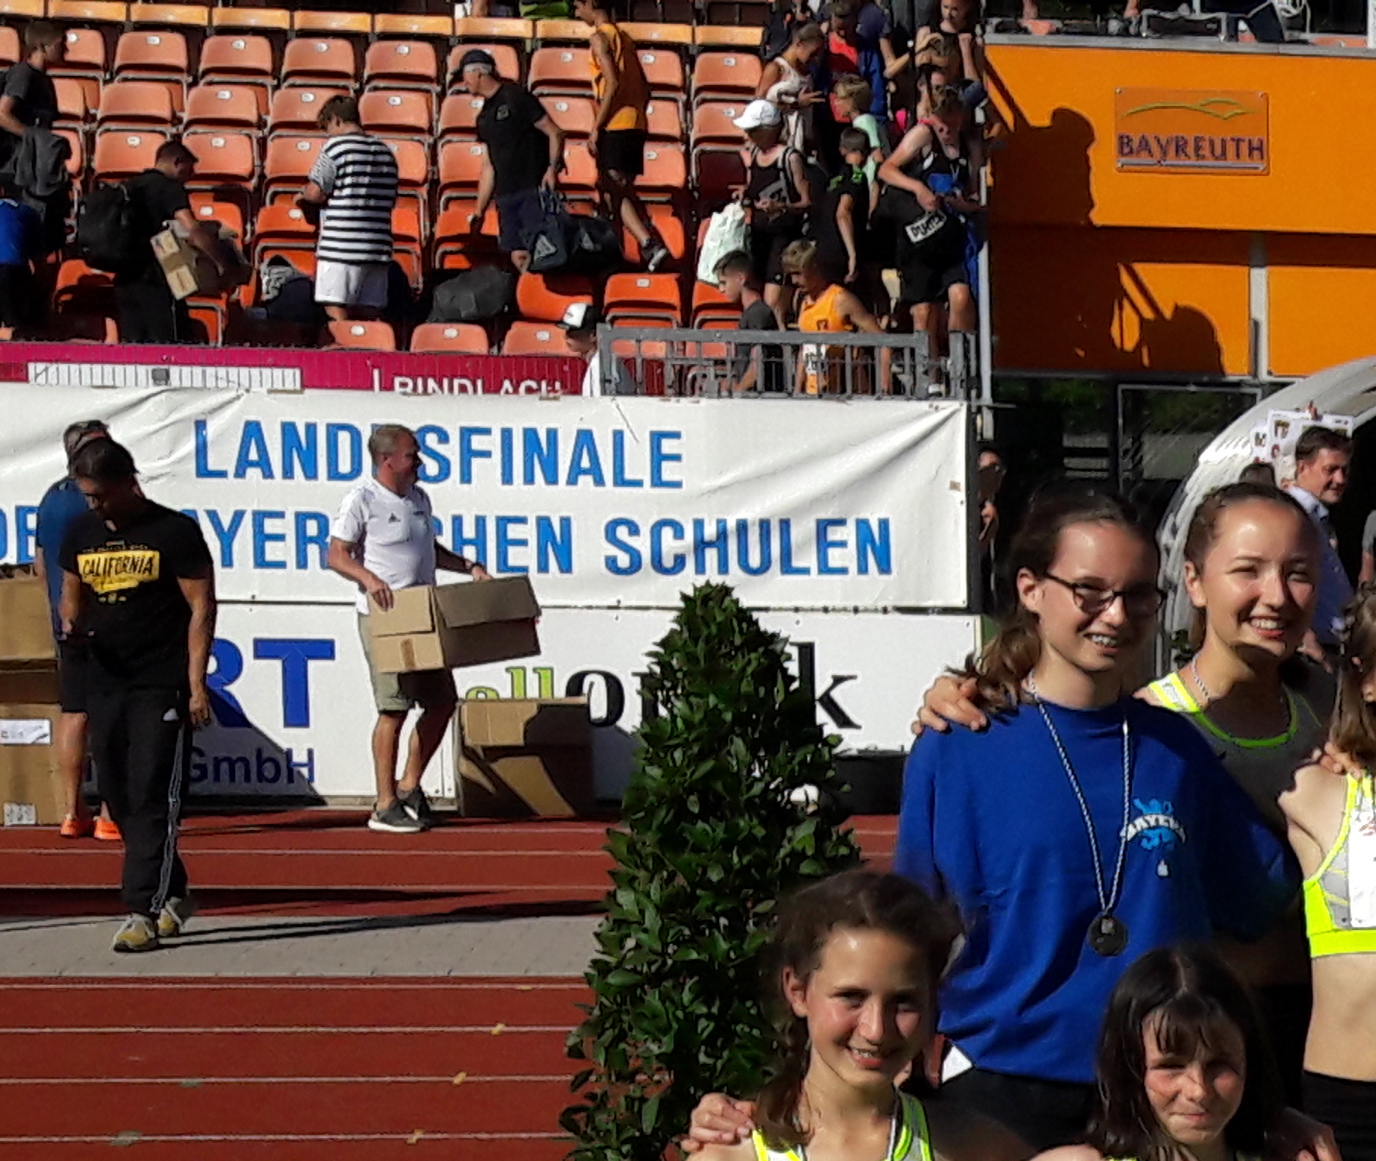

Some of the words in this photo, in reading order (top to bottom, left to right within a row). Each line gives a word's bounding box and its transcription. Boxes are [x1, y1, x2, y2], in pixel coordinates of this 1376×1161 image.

[1118, 134, 1265, 163] BAYREUTH
[194, 420, 683, 488] LANDSFINALE
[82, 554, 156, 577] CALIFORNIA
[604, 517, 893, 575] SCHULEN
[189, 746, 314, 786] GmbH
